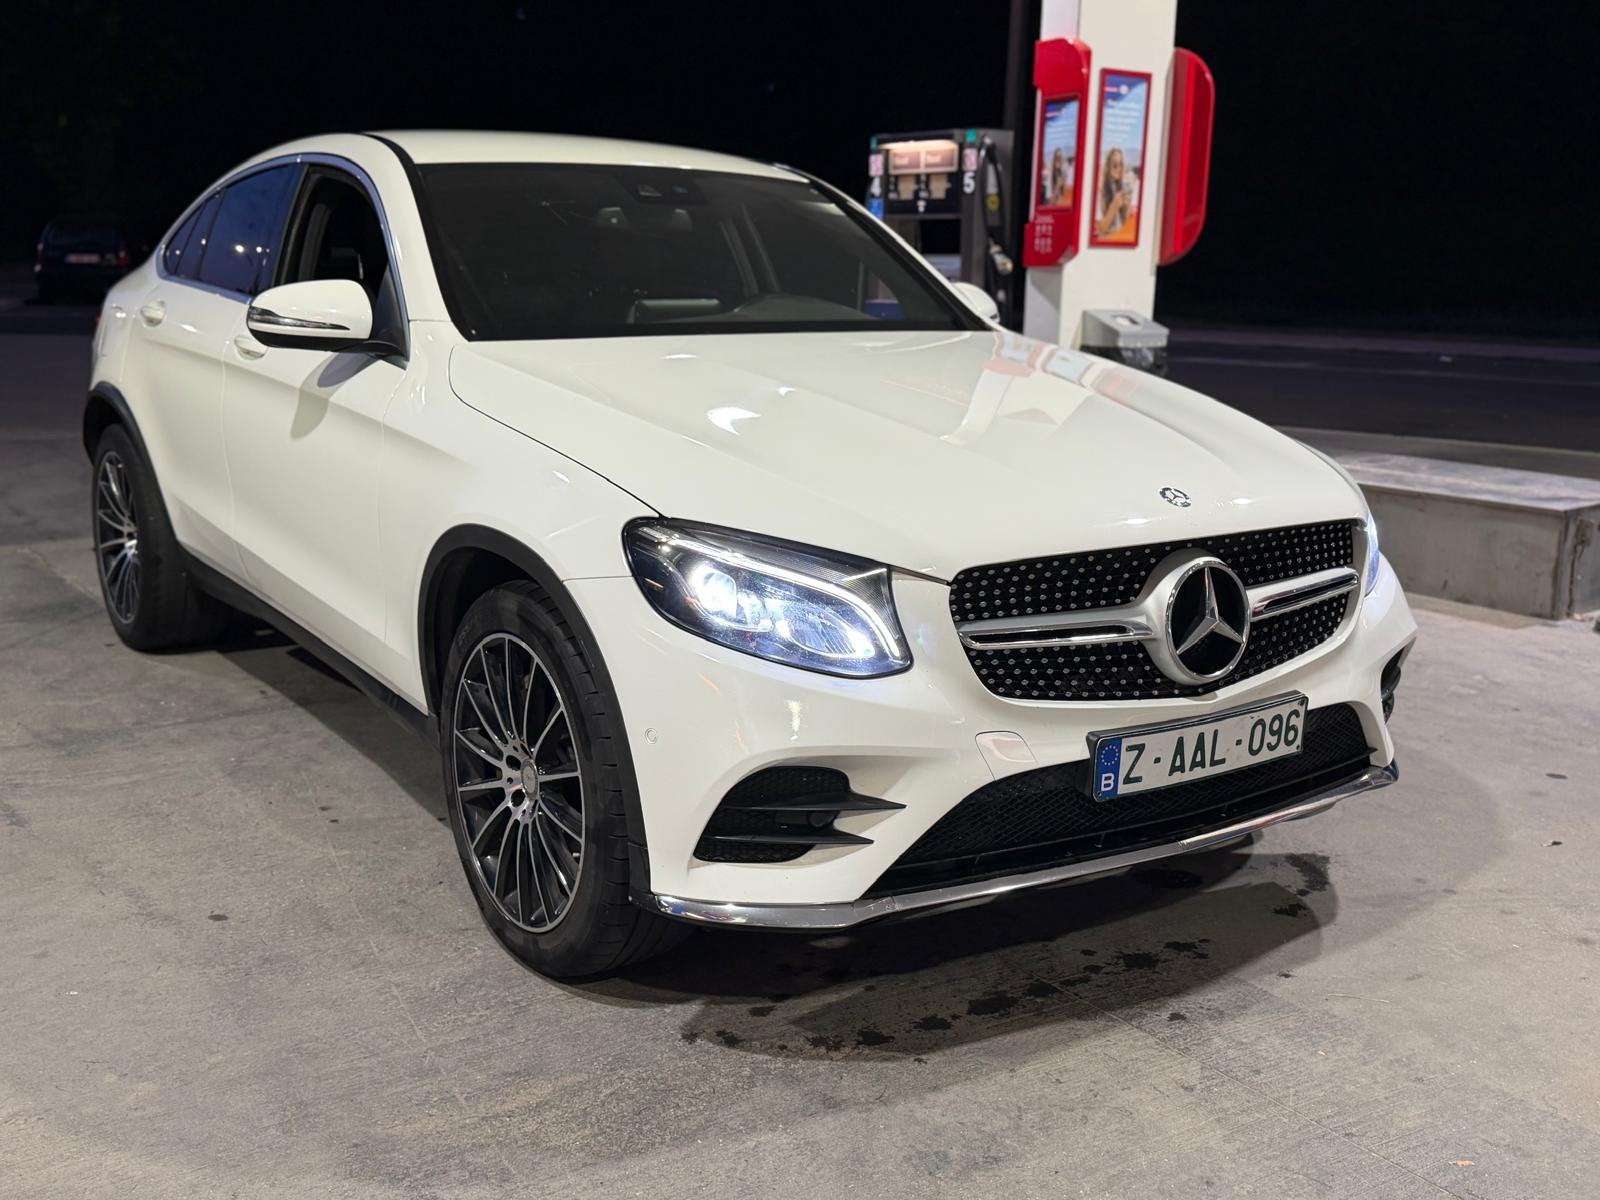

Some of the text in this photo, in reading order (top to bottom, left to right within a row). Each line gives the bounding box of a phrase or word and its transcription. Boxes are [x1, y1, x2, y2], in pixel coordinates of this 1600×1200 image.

[963, 172, 976, 194] 5
[1122, 709, 1301, 786] Z-AAL-096
[1100, 773, 1115, 792] B
